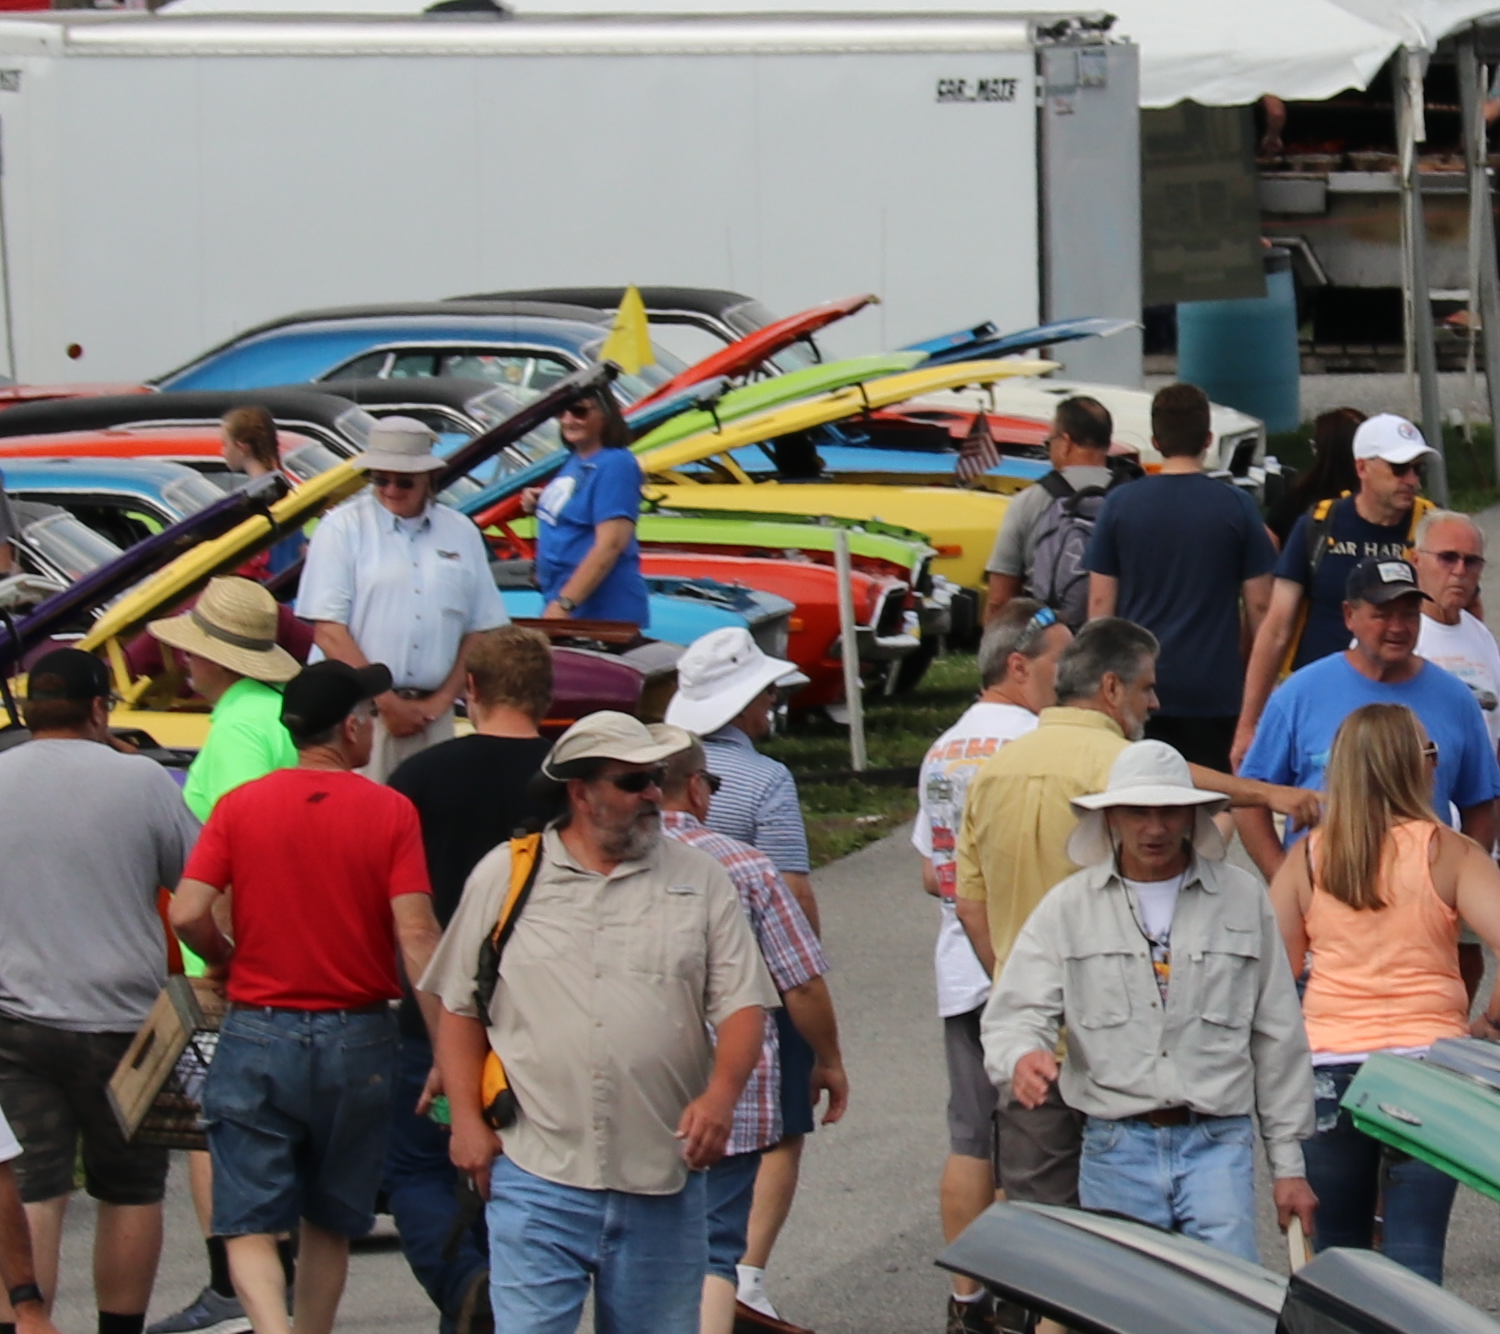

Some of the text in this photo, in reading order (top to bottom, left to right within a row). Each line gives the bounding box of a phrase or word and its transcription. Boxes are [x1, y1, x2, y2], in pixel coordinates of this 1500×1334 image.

[1329, 541, 1406, 560] AR HAR
[929, 737, 1013, 762] HEM
